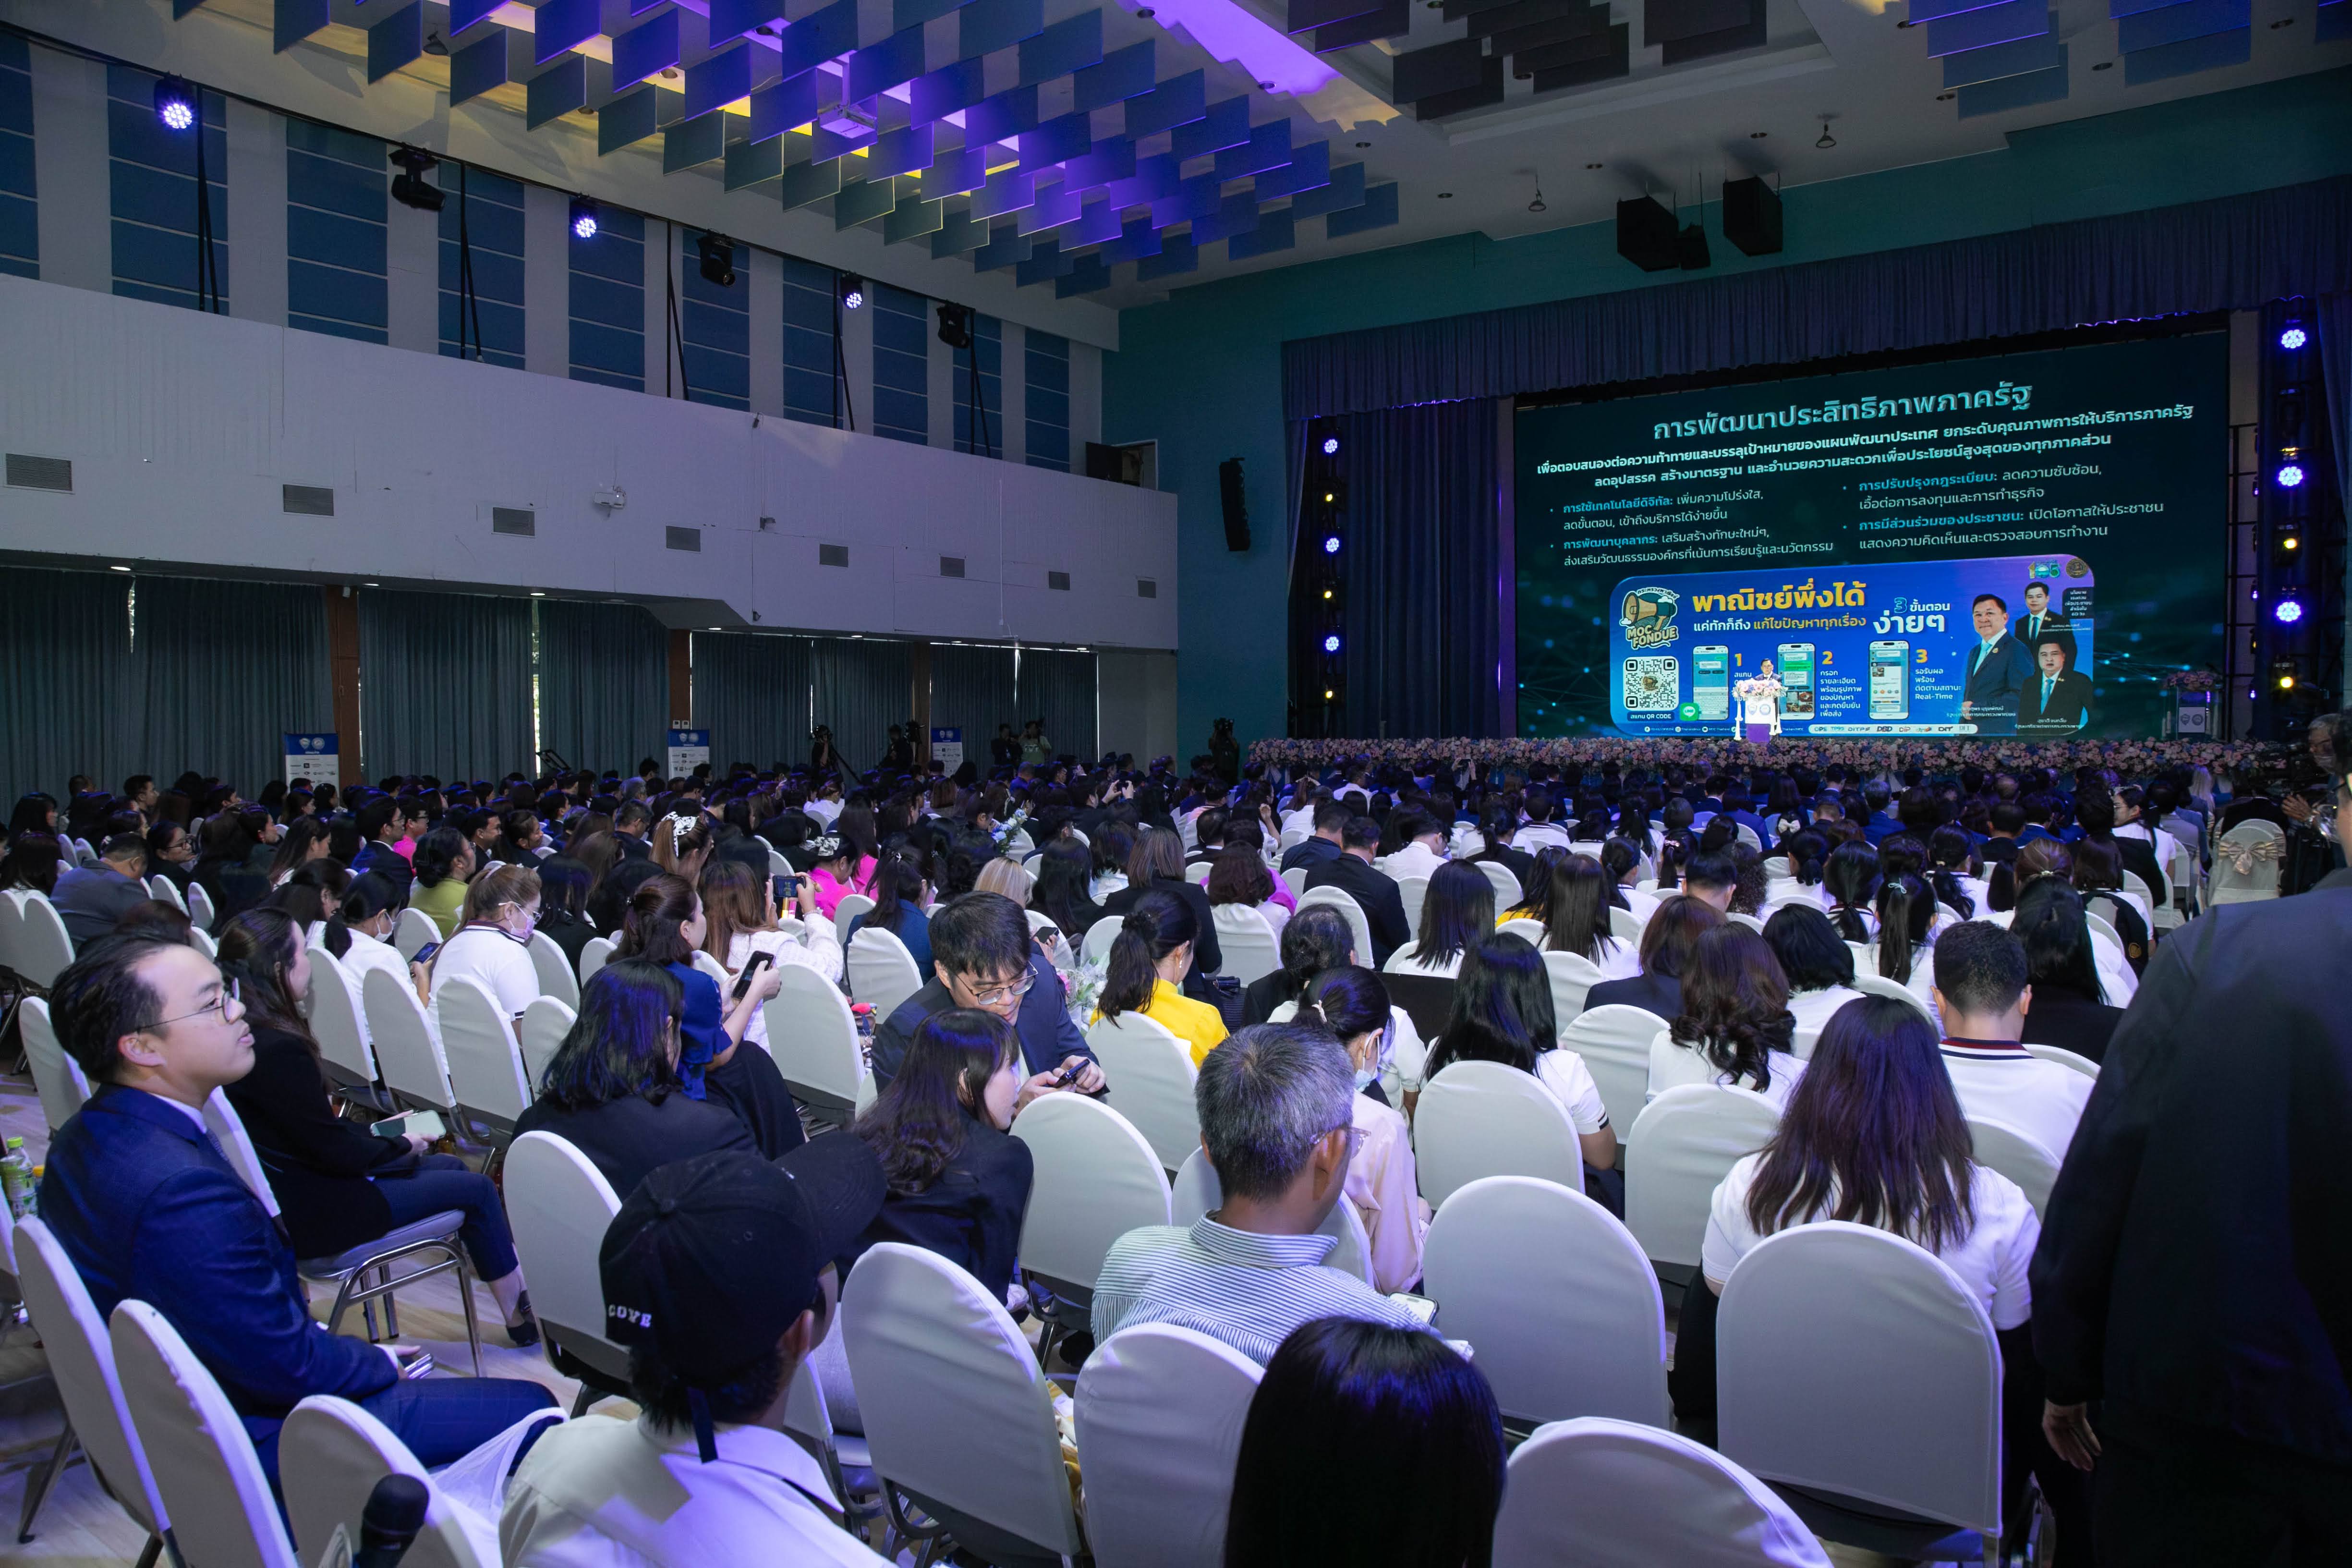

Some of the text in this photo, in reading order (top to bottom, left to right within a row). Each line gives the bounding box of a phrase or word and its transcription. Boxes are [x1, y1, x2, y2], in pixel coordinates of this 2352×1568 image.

[1654, 381, 2032, 439] การพัฒนาประสิทธิภาพภาครัฐ
[1538, 404, 2194, 474] เพื่อตอบสนองต่อความท้าทายและบรรลุเป้าหมายของแผนพัฒนาประเทศ ยกระดับคุณภาพการให้บริการภาครัฐ
[1595, 433, 2111, 488] ลดอุปสรรค สร้างมาตรฐาน และอำนวยความสะดวกเพื่อประโยชน์สูงสุดของทุกภาคส่วน
[1859, 464, 2102, 491] การปรับปรุงกฎระเบียบ: ลดความซับซ้อน,
[1564, 489, 1763, 513] การใช้เทคโนโลยีดิจิทัล: เพิ่มความโปร่งใส,
[1859, 487, 2044, 510] เอื้อต่อการลงทุนและการทำธุรกิจ
[1564, 507, 1727, 530] ลดขั้นตอน, เข้าถึงบริการได้ง่ายขึ้น
[1859, 502, 2164, 531] การมีส่วนร่วมของประชาชน: เปิดโอกาสให้ประชาชน
[1564, 527, 1769, 549] การพัฒนาบุคลากร: เสริมสร้างทักษะใหม่ๆ,
[1859, 526, 2108, 549] แสดงความคิดเห็นและตรวจสอบการทำงาน
[1564, 541, 1833, 566] ส่งเสริมวัฒนธรรมองค์กรที่เน้นการเรียนรู้และนวัตกรรม
[1693, 578, 1867, 612] พาณิชย์พึ่งได้
[1894, 597, 1951, 613] 3 ขั้นตอน
[1626, 624, 1652, 640] MOC
[1694, 613, 1867, 632] แค่ทักก็ถึง แก้ไขปัญหาทุกเรื่อง
[1873, 610, 1945, 634] ง่ายๆ
[1632, 627, 1678, 648] FONDUE
[1734, 653, 1742, 667] 1
[1822, 651, 1833, 665] 2
[1916, 649, 1928, 663] 3
